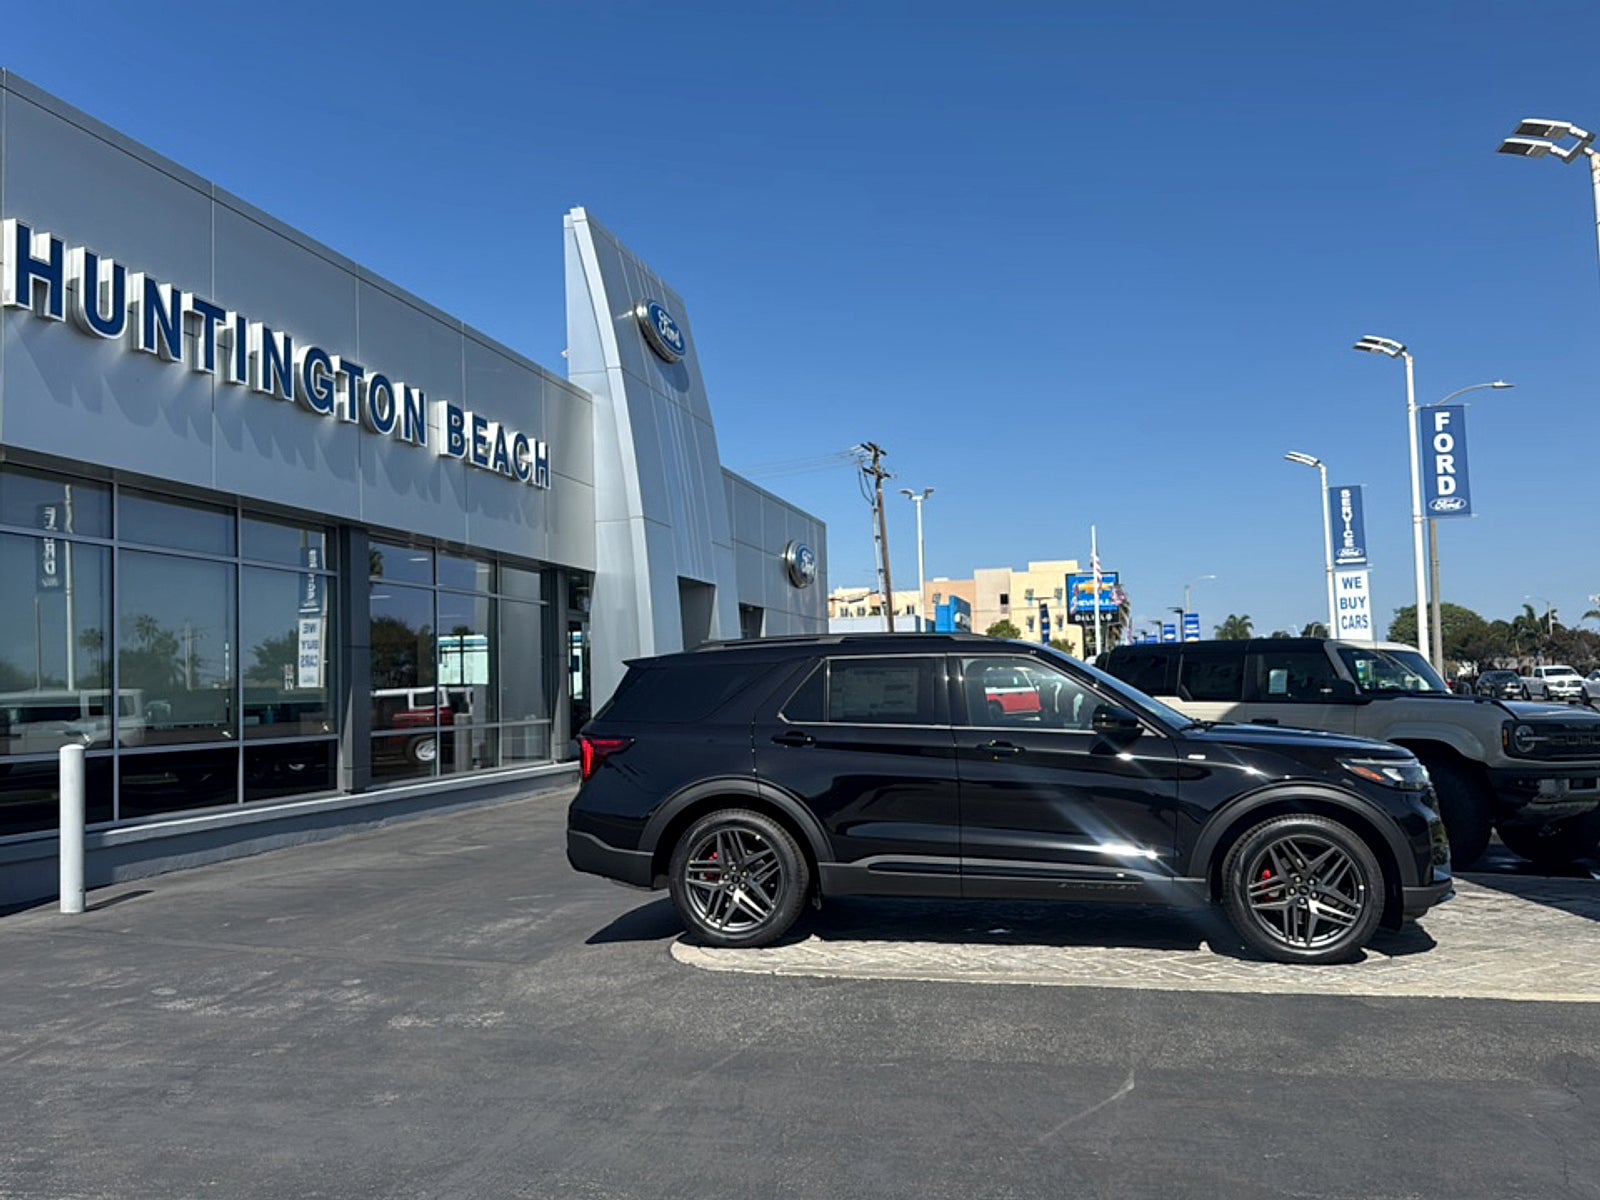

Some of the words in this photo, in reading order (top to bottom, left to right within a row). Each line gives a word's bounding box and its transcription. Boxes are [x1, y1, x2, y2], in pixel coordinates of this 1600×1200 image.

[2, 218, 428, 447] HUNTINGTON
[437, 400, 551, 489] BEACH
[1433, 411, 1456, 496] FORD
[1433, 498, 1462, 511] Ford
[1340, 488, 1354, 548] SERVICE
[1341, 576, 1363, 590] WE
[1340, 596, 1367, 610] BUY
[1341, 614, 1369, 630] CARS
